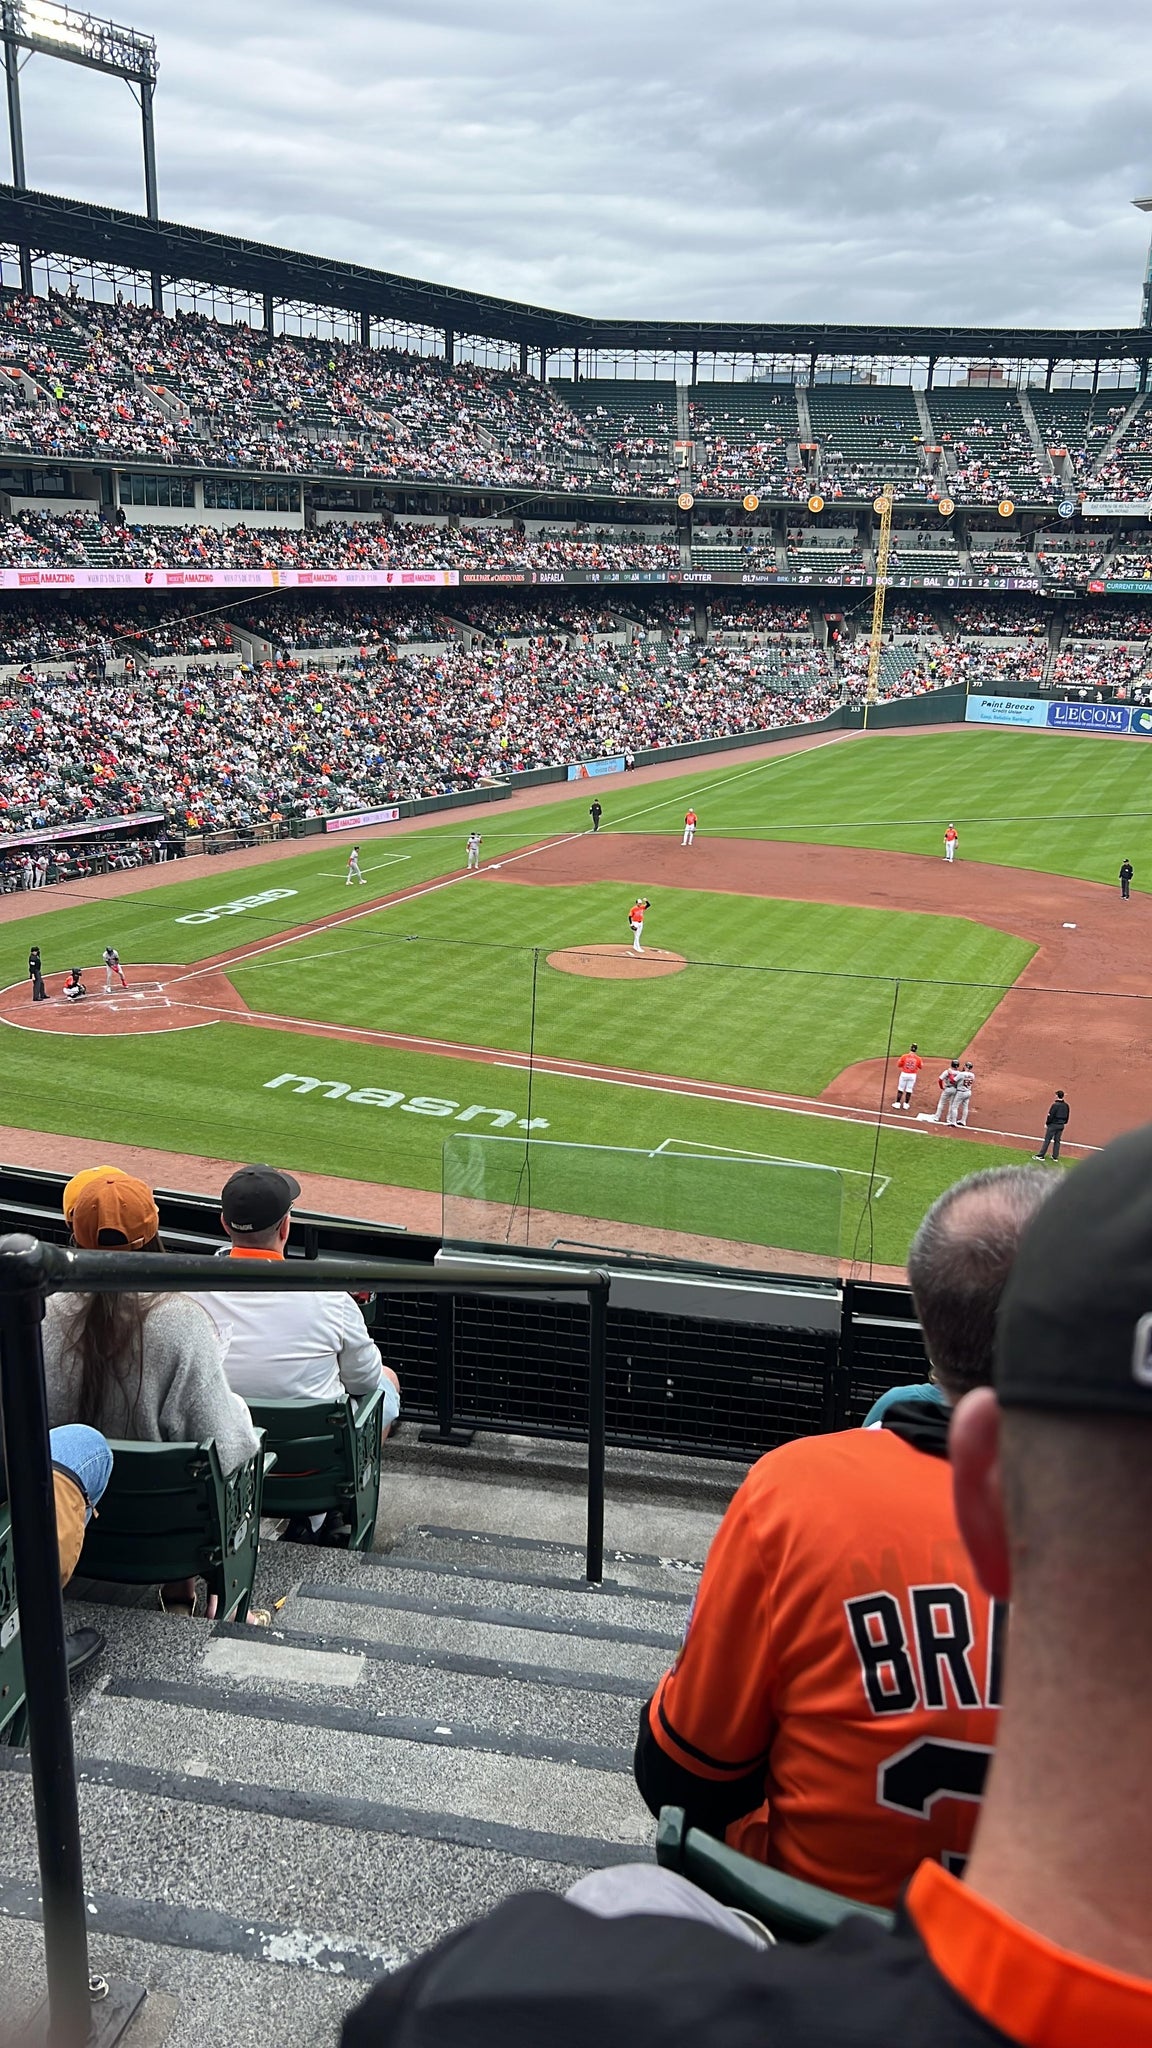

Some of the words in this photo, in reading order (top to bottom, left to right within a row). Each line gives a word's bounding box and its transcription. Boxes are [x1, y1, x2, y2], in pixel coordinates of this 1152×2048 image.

[680, 496, 691, 507] 20
[876, 501, 888, 511] 22
[941, 503, 951, 513] 33
[1060, 505, 1072, 514] 42
[40, 573, 75, 583] AMAZING
[184, 574, 213, 582] AMAZING
[540, 573, 564, 582] RAFAELA
[683, 573, 712, 582] CUTTER
[923, 577, 940, 587] BAL
[1013, 579, 1039, 589] 12:35
[1106, 582, 1133, 590] CURRENT
[1005, 702, 1035, 711] Breeze
[1054, 706, 1123, 724] LECOM
[174, 888, 299, 924] GEICO
